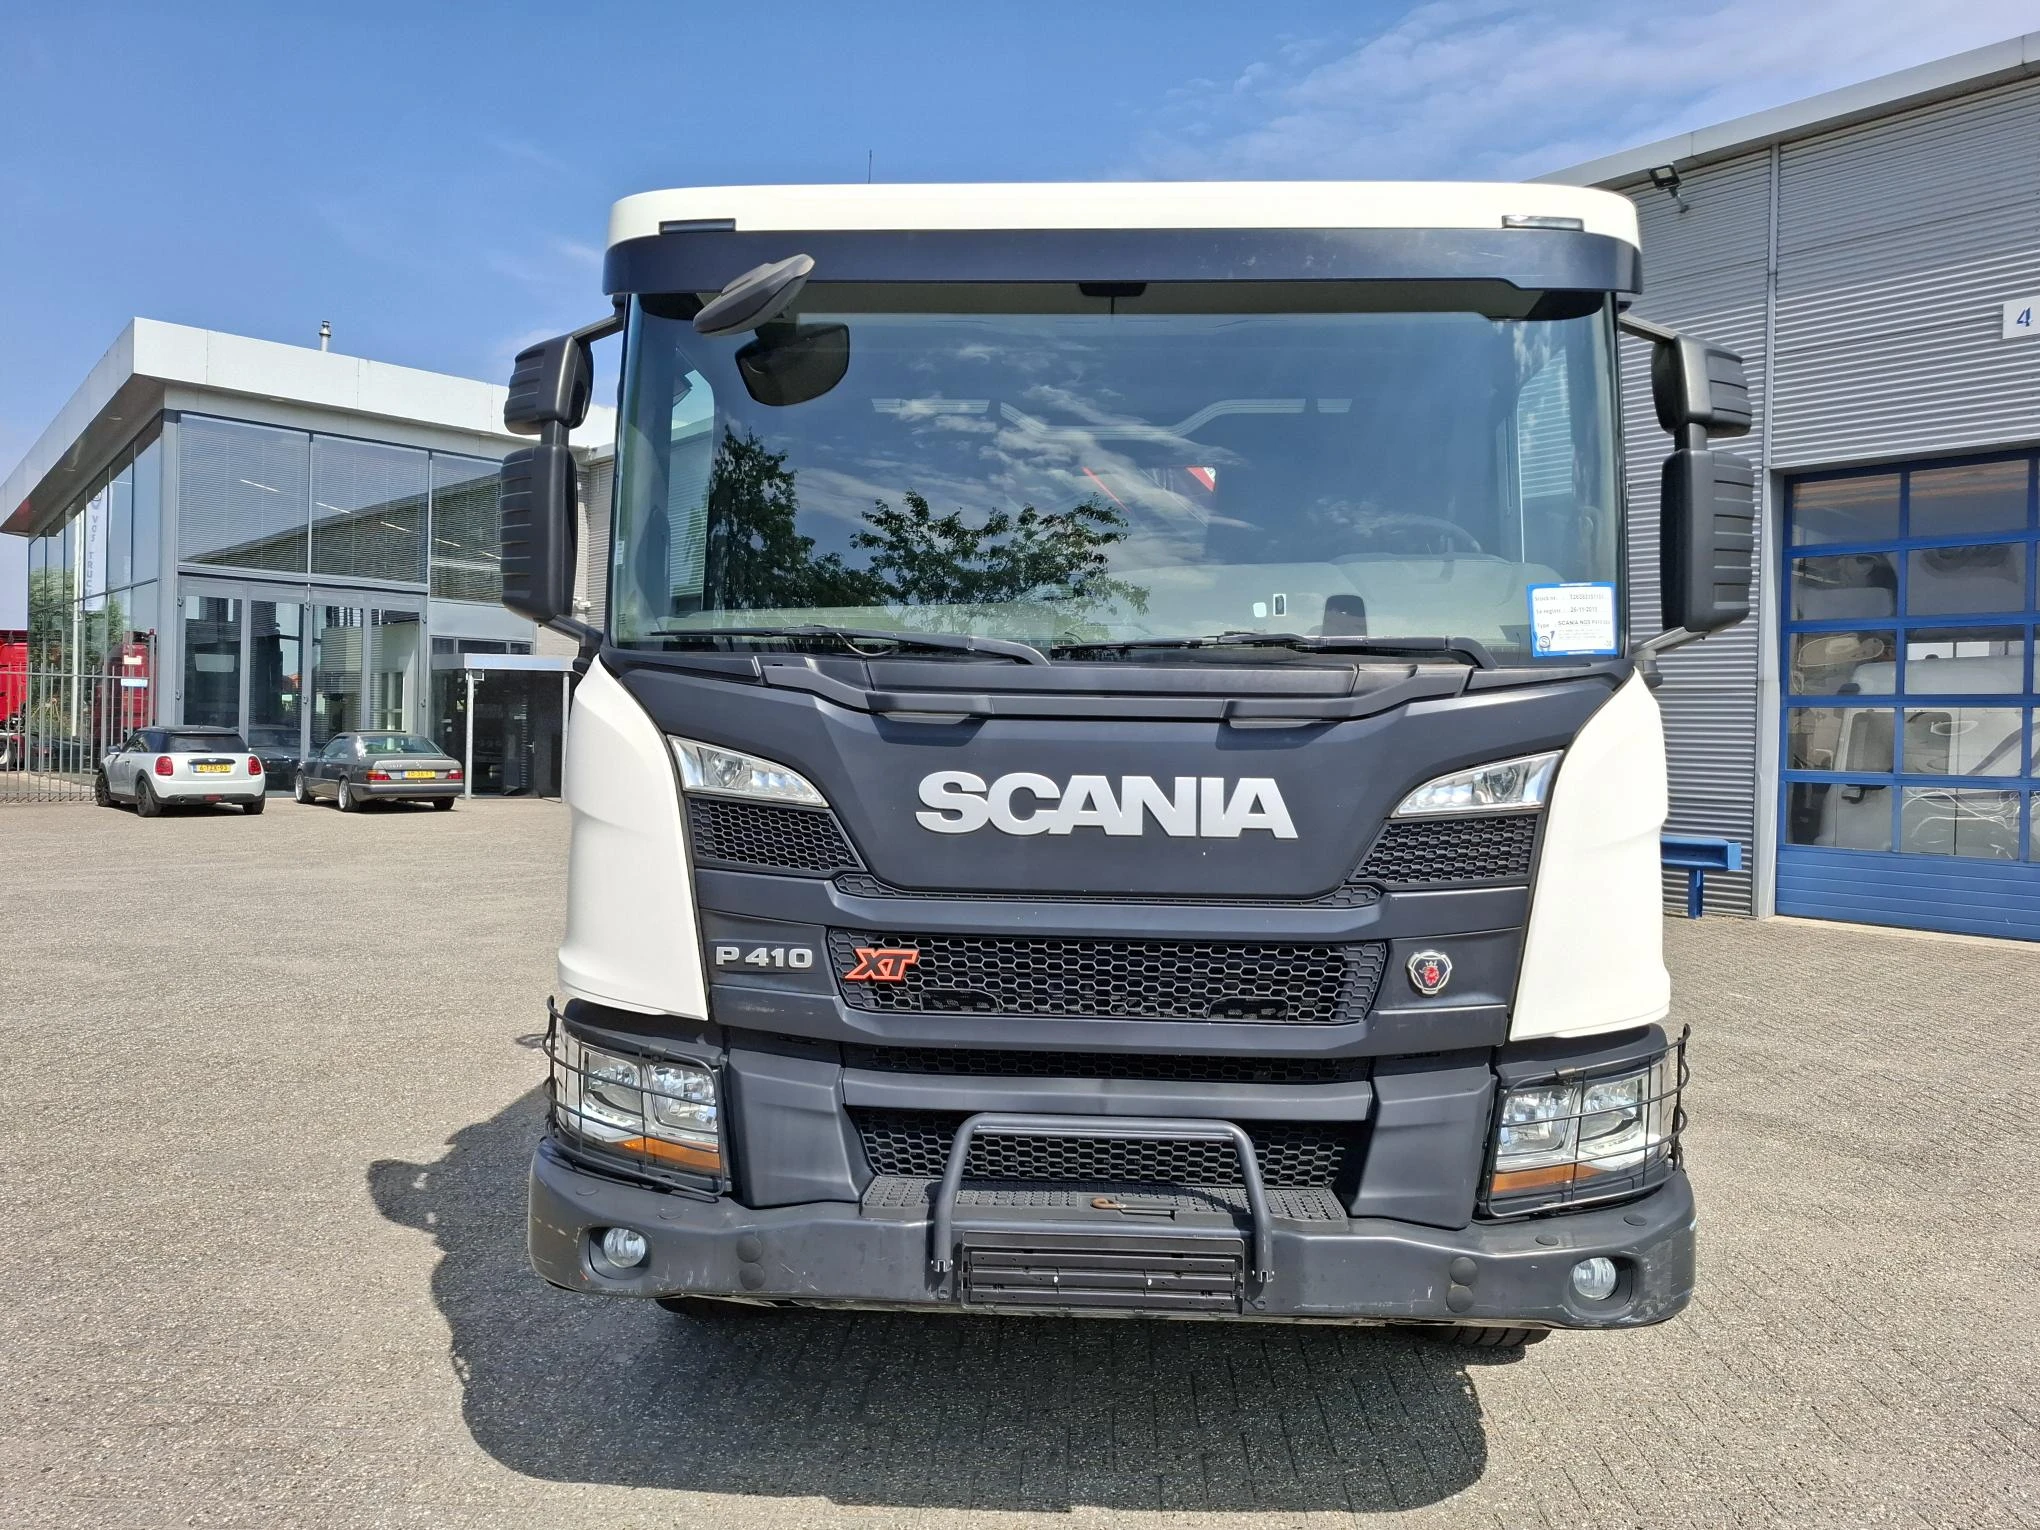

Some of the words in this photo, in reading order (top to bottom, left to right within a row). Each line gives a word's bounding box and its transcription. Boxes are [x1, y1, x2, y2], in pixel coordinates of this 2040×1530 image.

[2016, 306, 2032, 327] 4
[90, 515, 98, 543] VOS
[915, 770, 1299, 839] SCANIA
[715, 946, 740, 966] P
[745, 947, 813, 968] 410
[845, 948, 920, 981] XT
